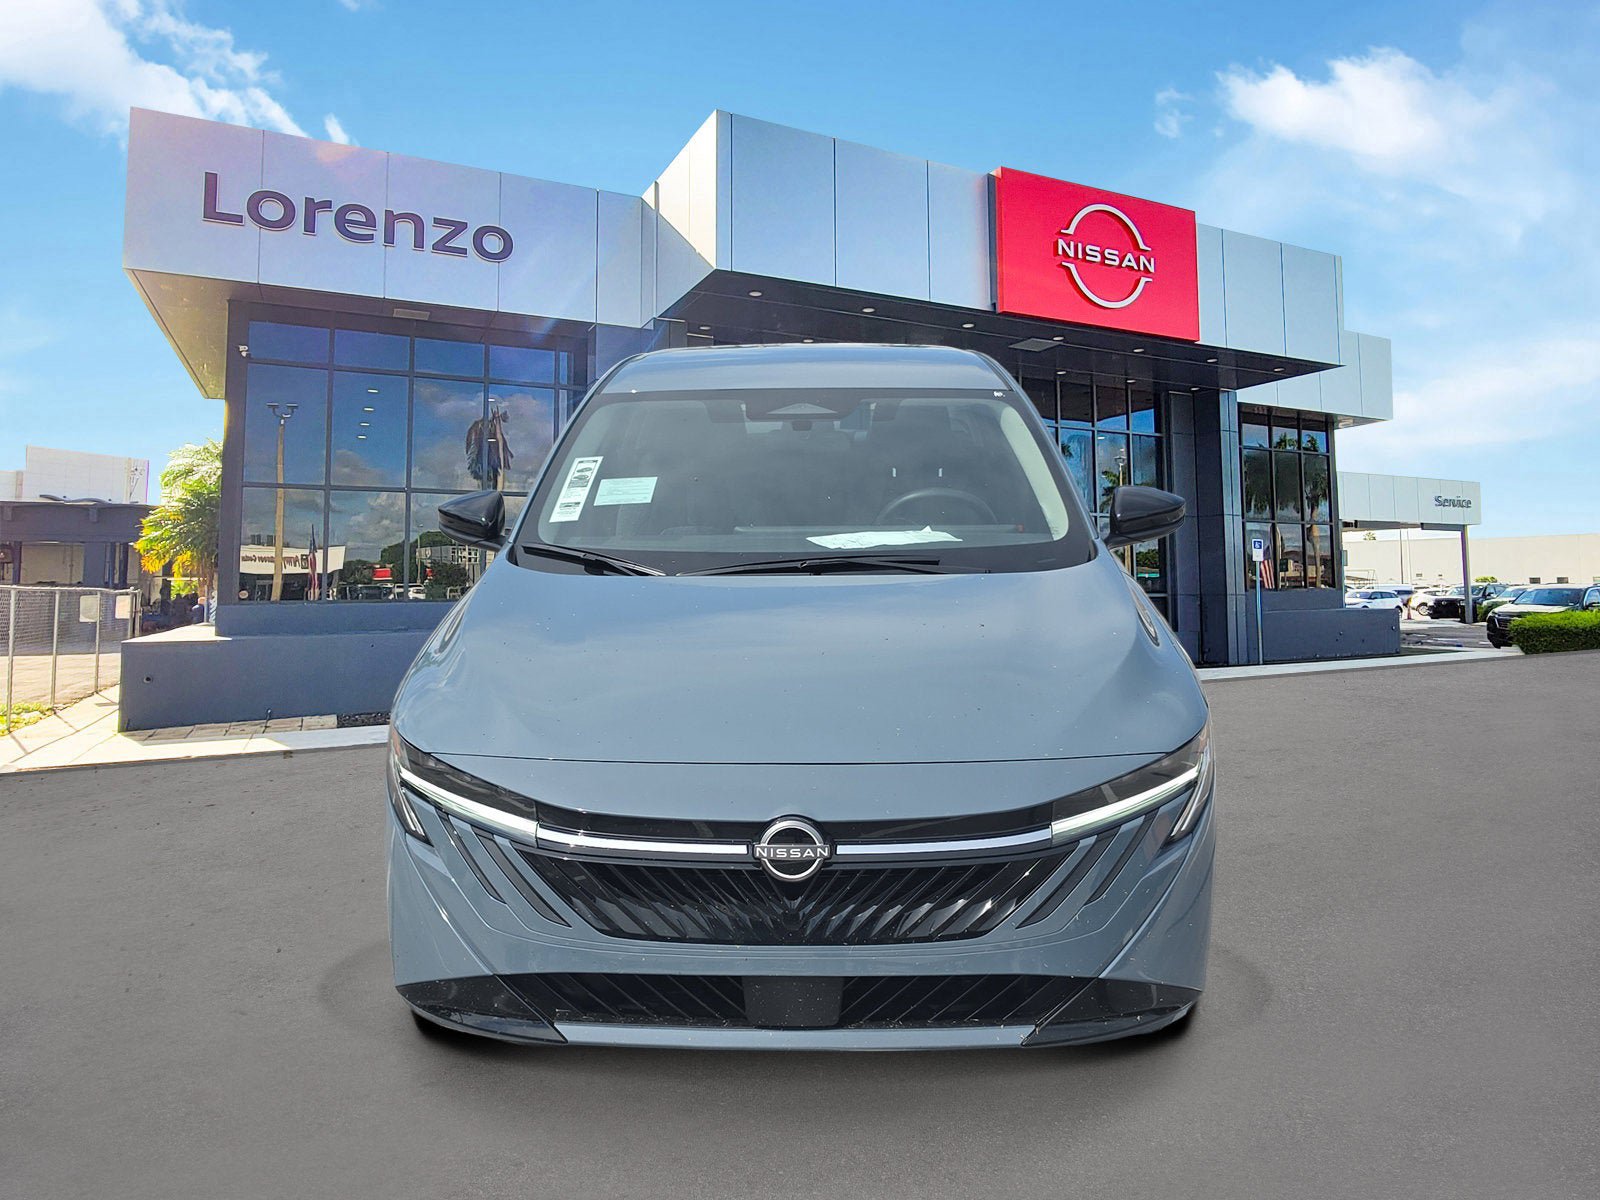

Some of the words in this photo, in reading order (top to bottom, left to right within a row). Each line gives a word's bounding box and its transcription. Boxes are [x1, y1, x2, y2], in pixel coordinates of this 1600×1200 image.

[202, 171, 514, 262] Lorenzo
[1057, 238, 1155, 273] NISSAN
[1434, 495, 1472, 508] Service
[756, 847, 829, 858] NISSAN
